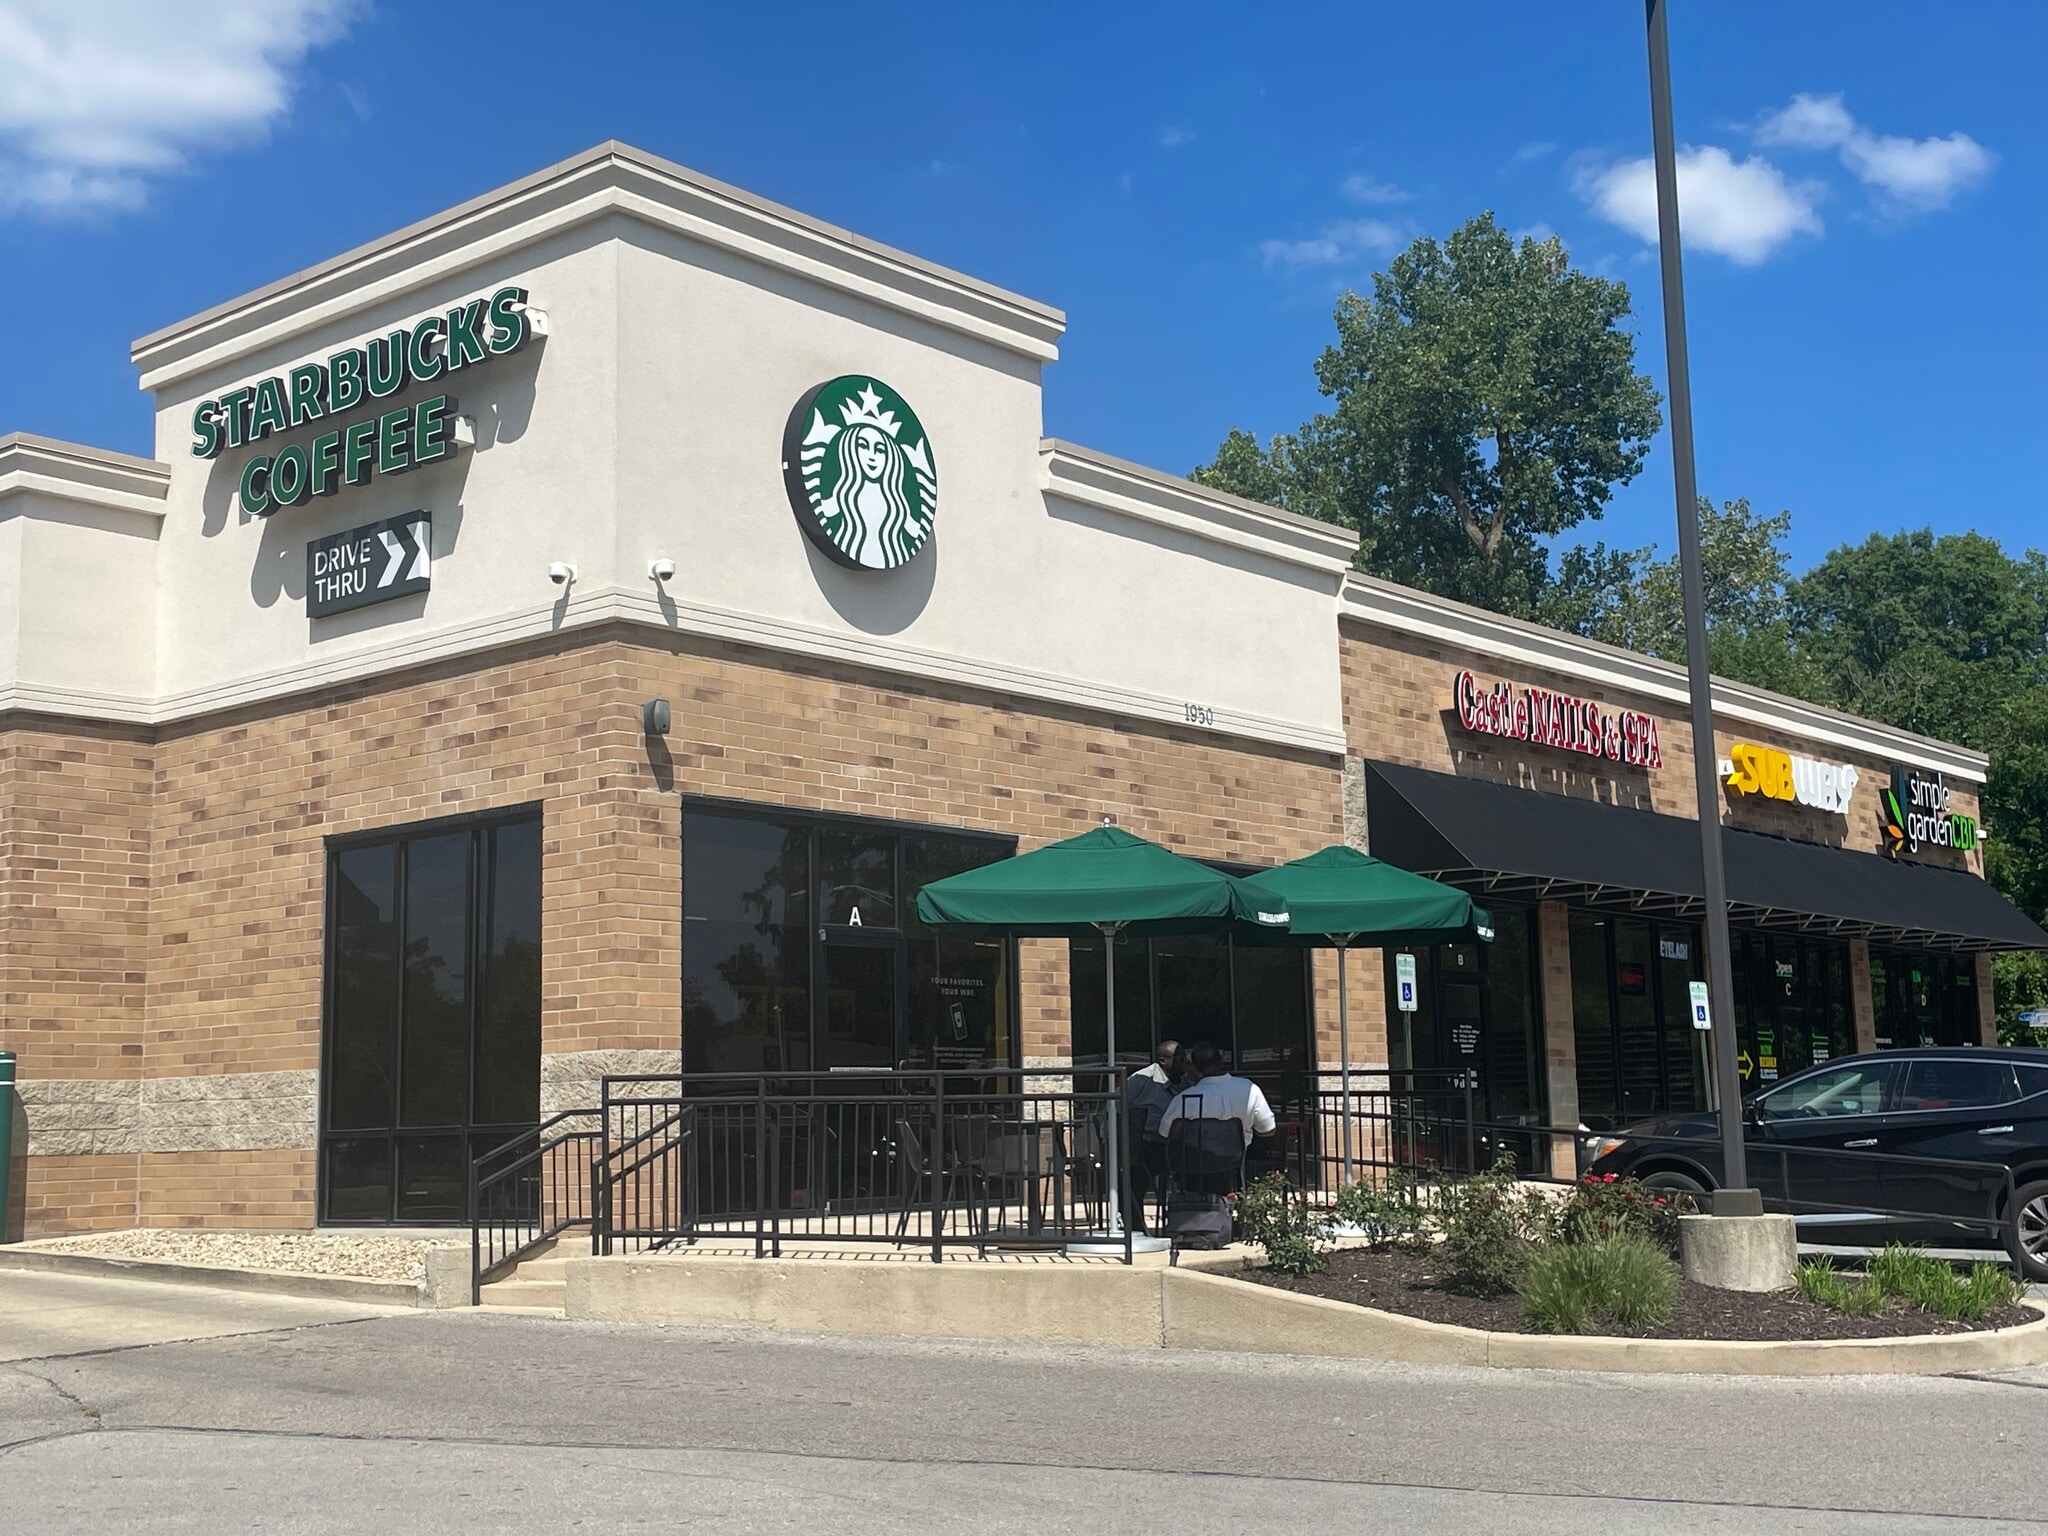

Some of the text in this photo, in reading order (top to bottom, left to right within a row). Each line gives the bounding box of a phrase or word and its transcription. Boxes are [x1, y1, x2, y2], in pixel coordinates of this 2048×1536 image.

[191, 287, 526, 459] STARBUCKS
[238, 394, 450, 515] COFFEE
[315, 538, 371, 576] DRIVE
[315, 567, 367, 603] THRU
[1184, 703, 1213, 726] 1950
[1457, 670, 1664, 769] Castle NAILS & SPA
[1727, 743, 1860, 814] SUBWAY
[1910, 771, 1951, 812] simple
[849, 906, 863, 927] A
[1457, 953, 1464, 966] B
[931, 977, 948, 985] YOUR
[1785, 983, 1792, 996] C
